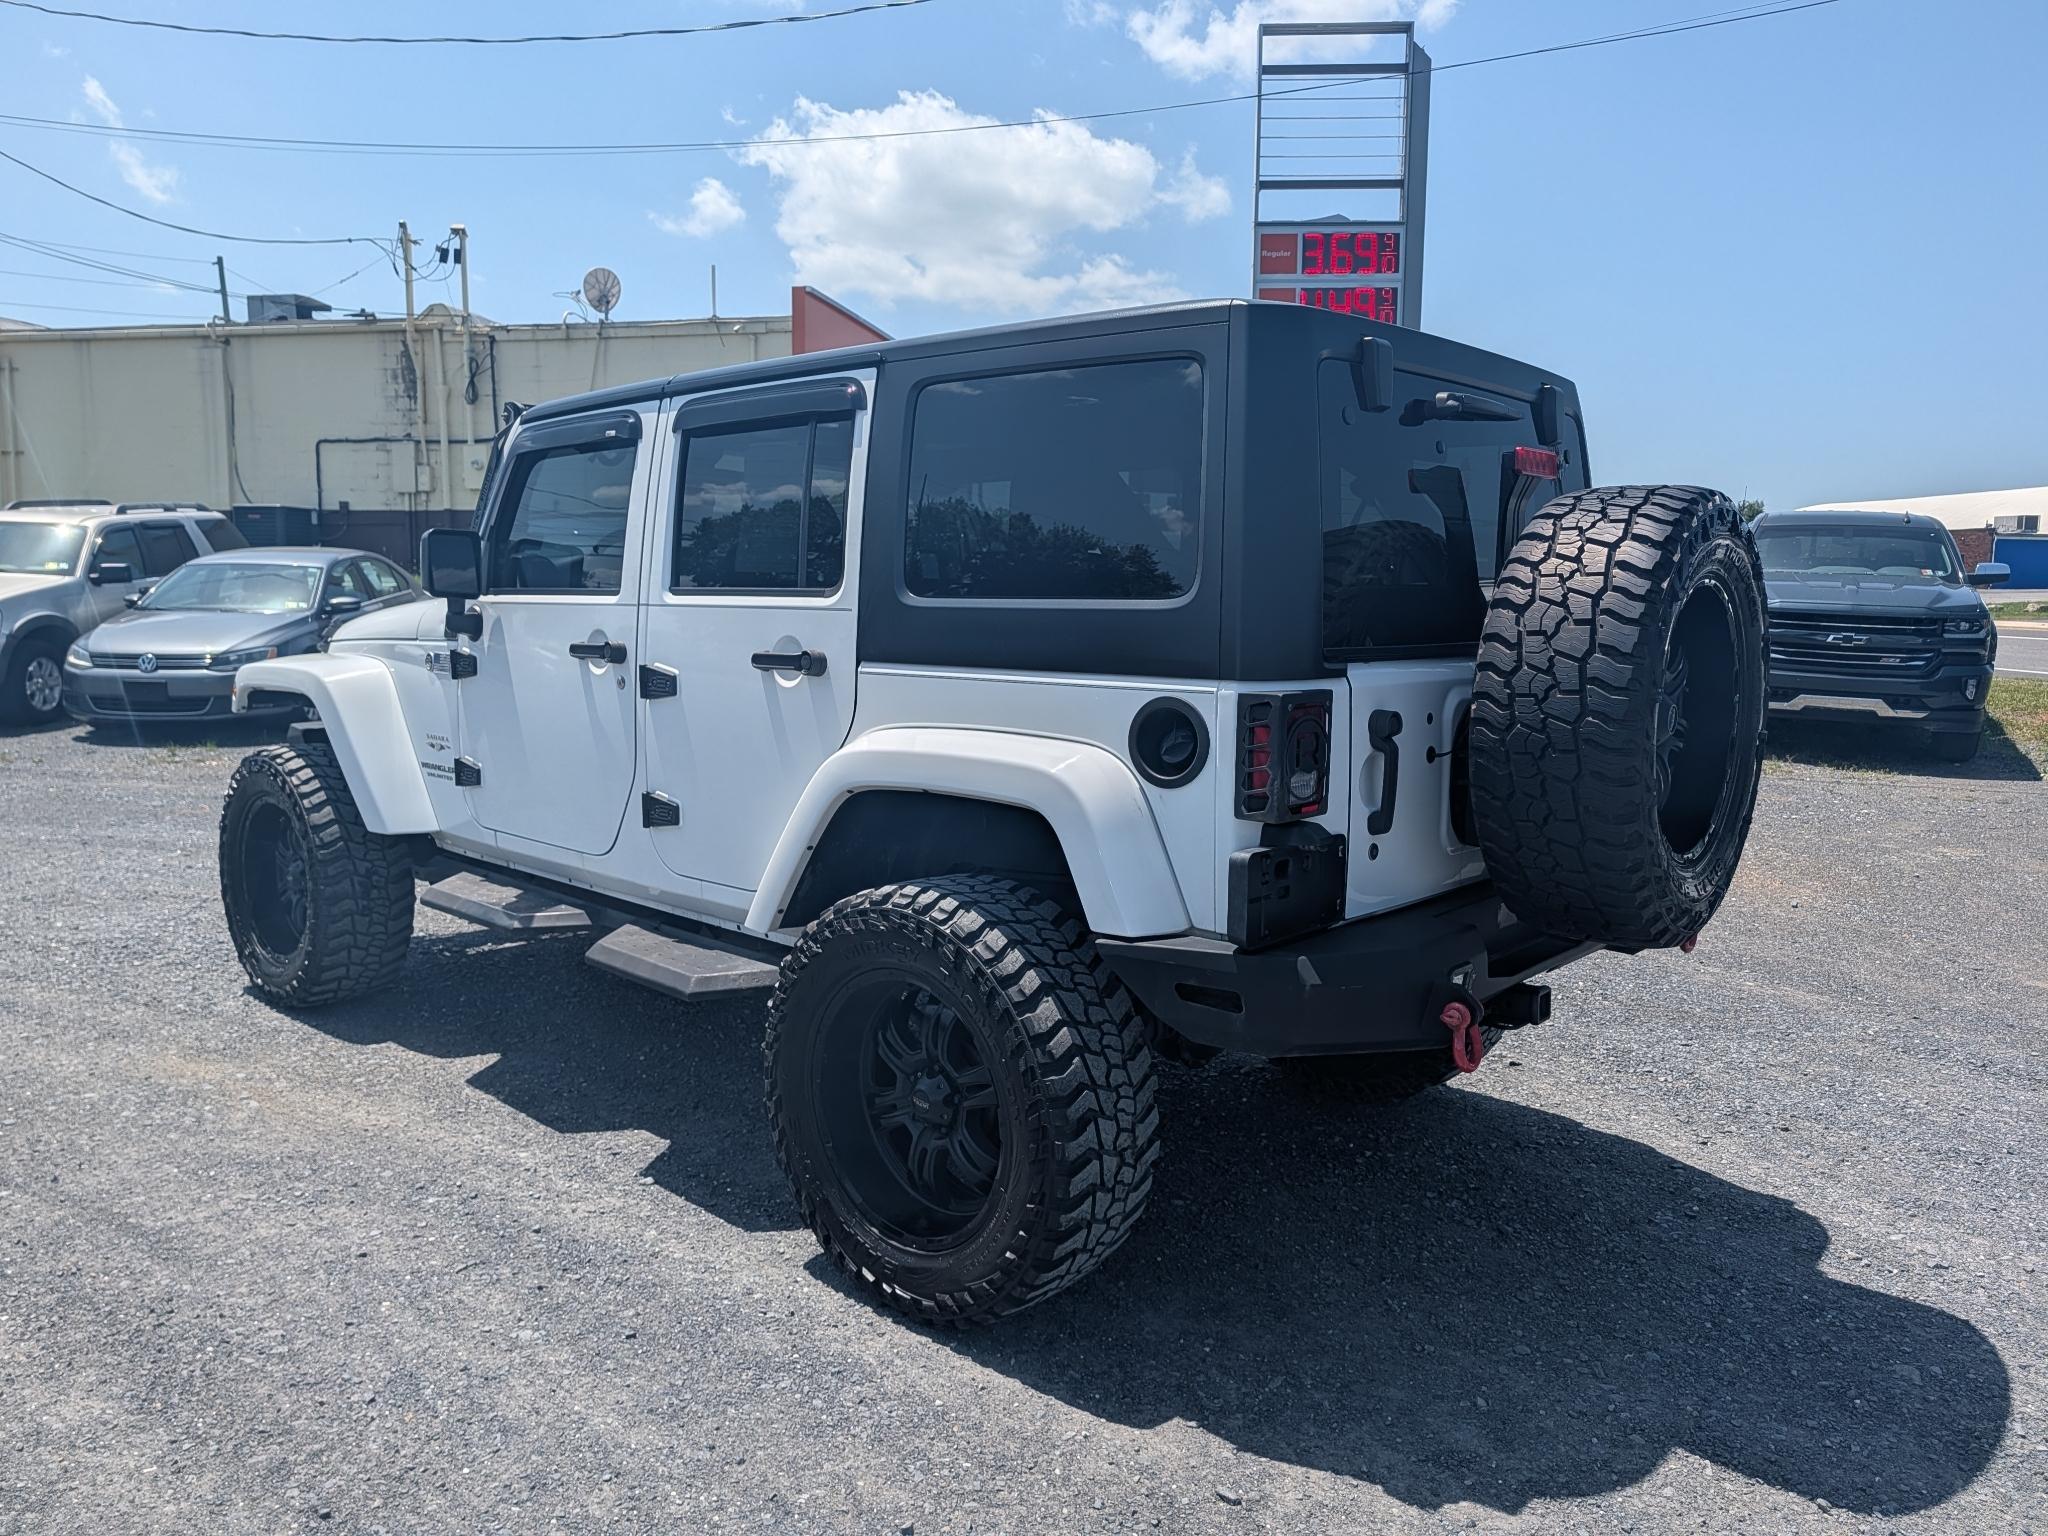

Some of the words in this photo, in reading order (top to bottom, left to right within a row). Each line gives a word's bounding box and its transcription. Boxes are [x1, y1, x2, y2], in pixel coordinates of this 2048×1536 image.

[1262, 249, 1291, 257] Regular
[1303, 233, 1378, 275] 3.69
[426, 733, 449, 742] SAHARA
